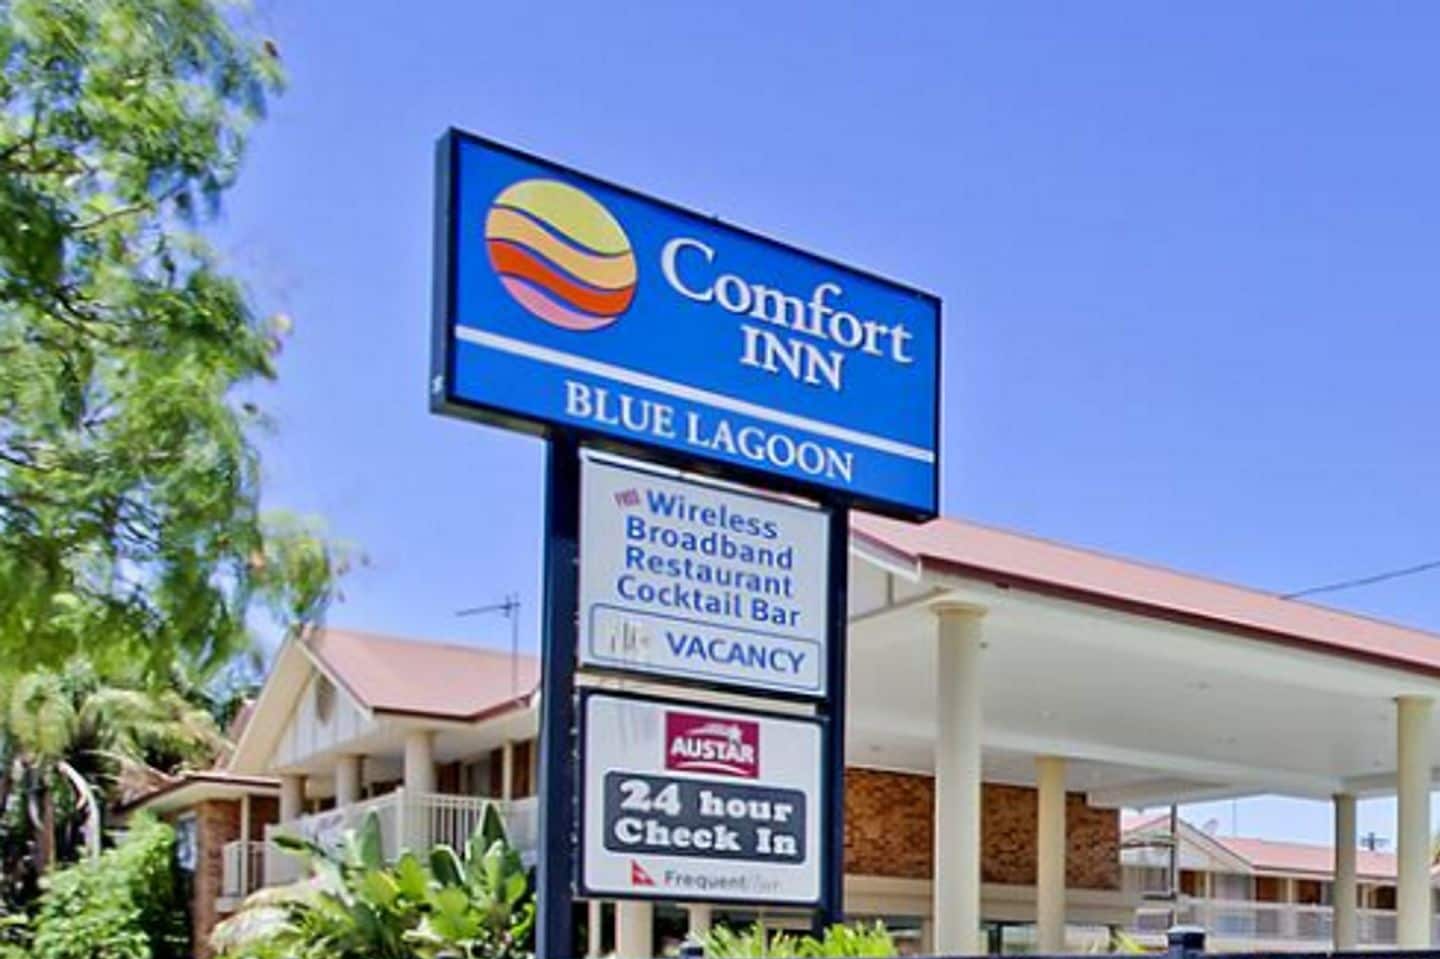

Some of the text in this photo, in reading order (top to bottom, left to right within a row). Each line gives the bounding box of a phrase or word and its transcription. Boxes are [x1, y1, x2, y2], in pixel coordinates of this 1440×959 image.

[660, 236, 914, 364] Comfort
[738, 323, 844, 391] INN
[564, 379, 855, 483] BLUE LAGOON
[646, 489, 778, 540] Wireless
[625, 514, 793, 571] Broadband
[625, 544, 791, 599] Restaurant
[616, 573, 801, 627] Cocktail Bar
[665, 630, 806, 674] VACANCY
[670, 736, 754, 764] AUSTAR
[619, 778, 793, 822] 24 hour
[614, 816, 797, 855] Check In
[663, 869, 746, 890] Frequent
